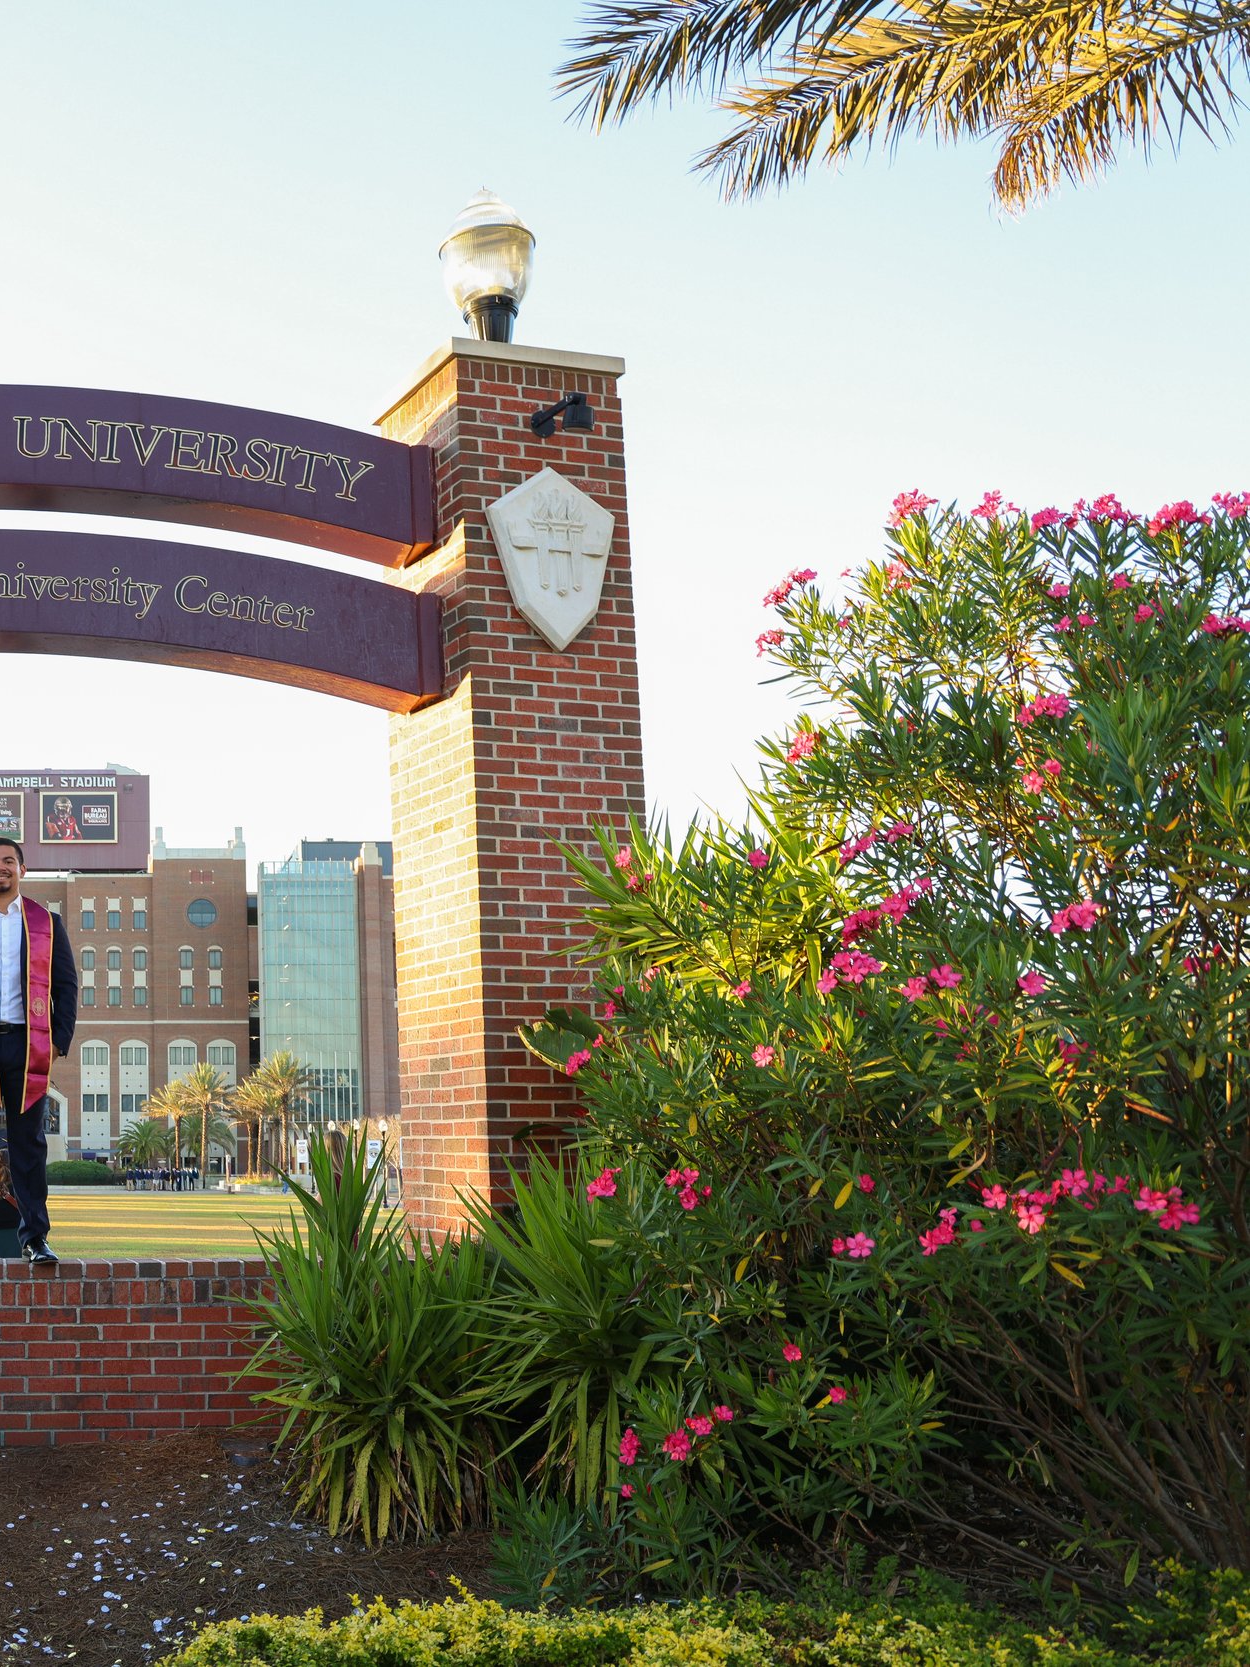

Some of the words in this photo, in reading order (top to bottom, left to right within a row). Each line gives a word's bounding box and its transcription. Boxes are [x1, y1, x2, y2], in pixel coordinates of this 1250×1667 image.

[13, 415, 374, 502] UNIVERSITY
[174, 575, 315, 632] Center
[60, 776, 116, 788] STADIUM
